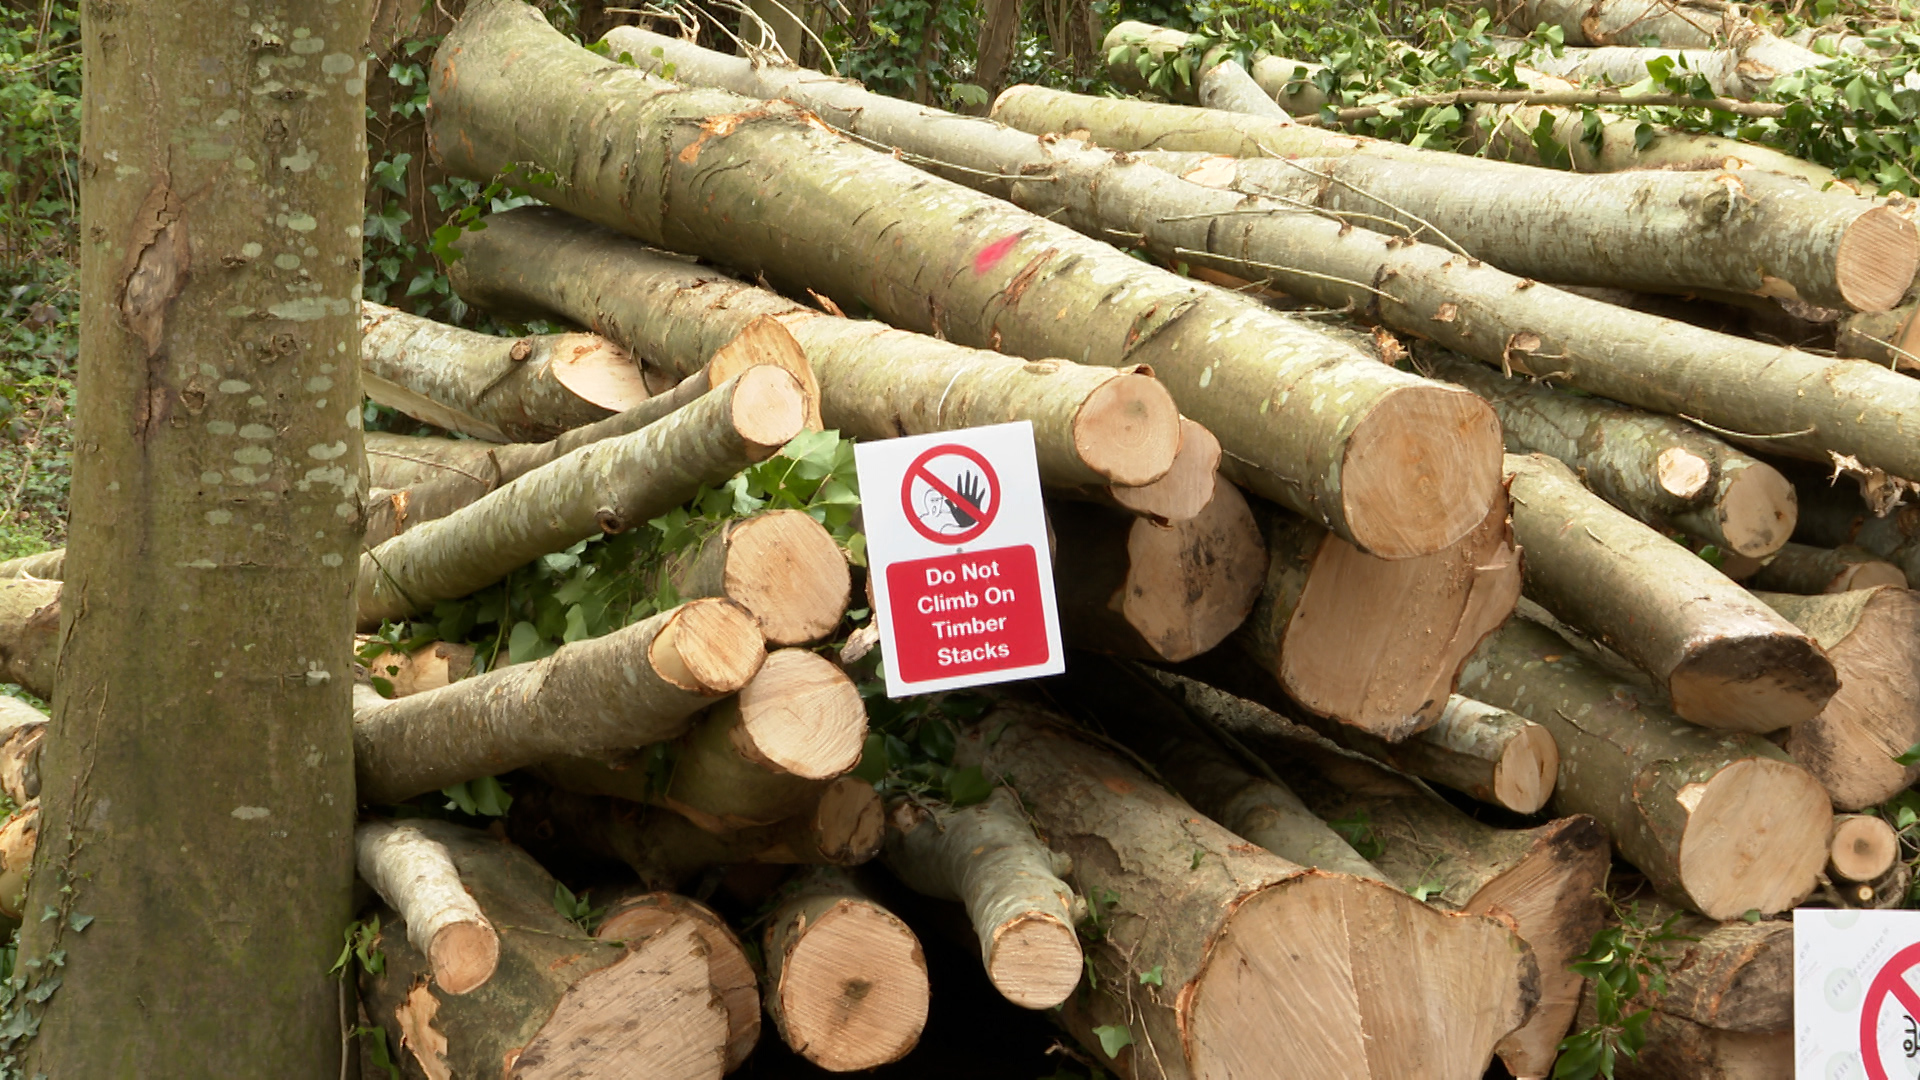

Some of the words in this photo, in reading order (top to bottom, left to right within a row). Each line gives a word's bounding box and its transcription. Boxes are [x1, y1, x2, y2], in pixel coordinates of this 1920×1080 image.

[926, 568, 955, 586] Do
[962, 561, 1000, 581] Not
[918, 591, 978, 614] Climb
[985, 587, 1015, 605] On
[932, 617, 1007, 639] Timber
[938, 642, 1009, 666] Stacks
